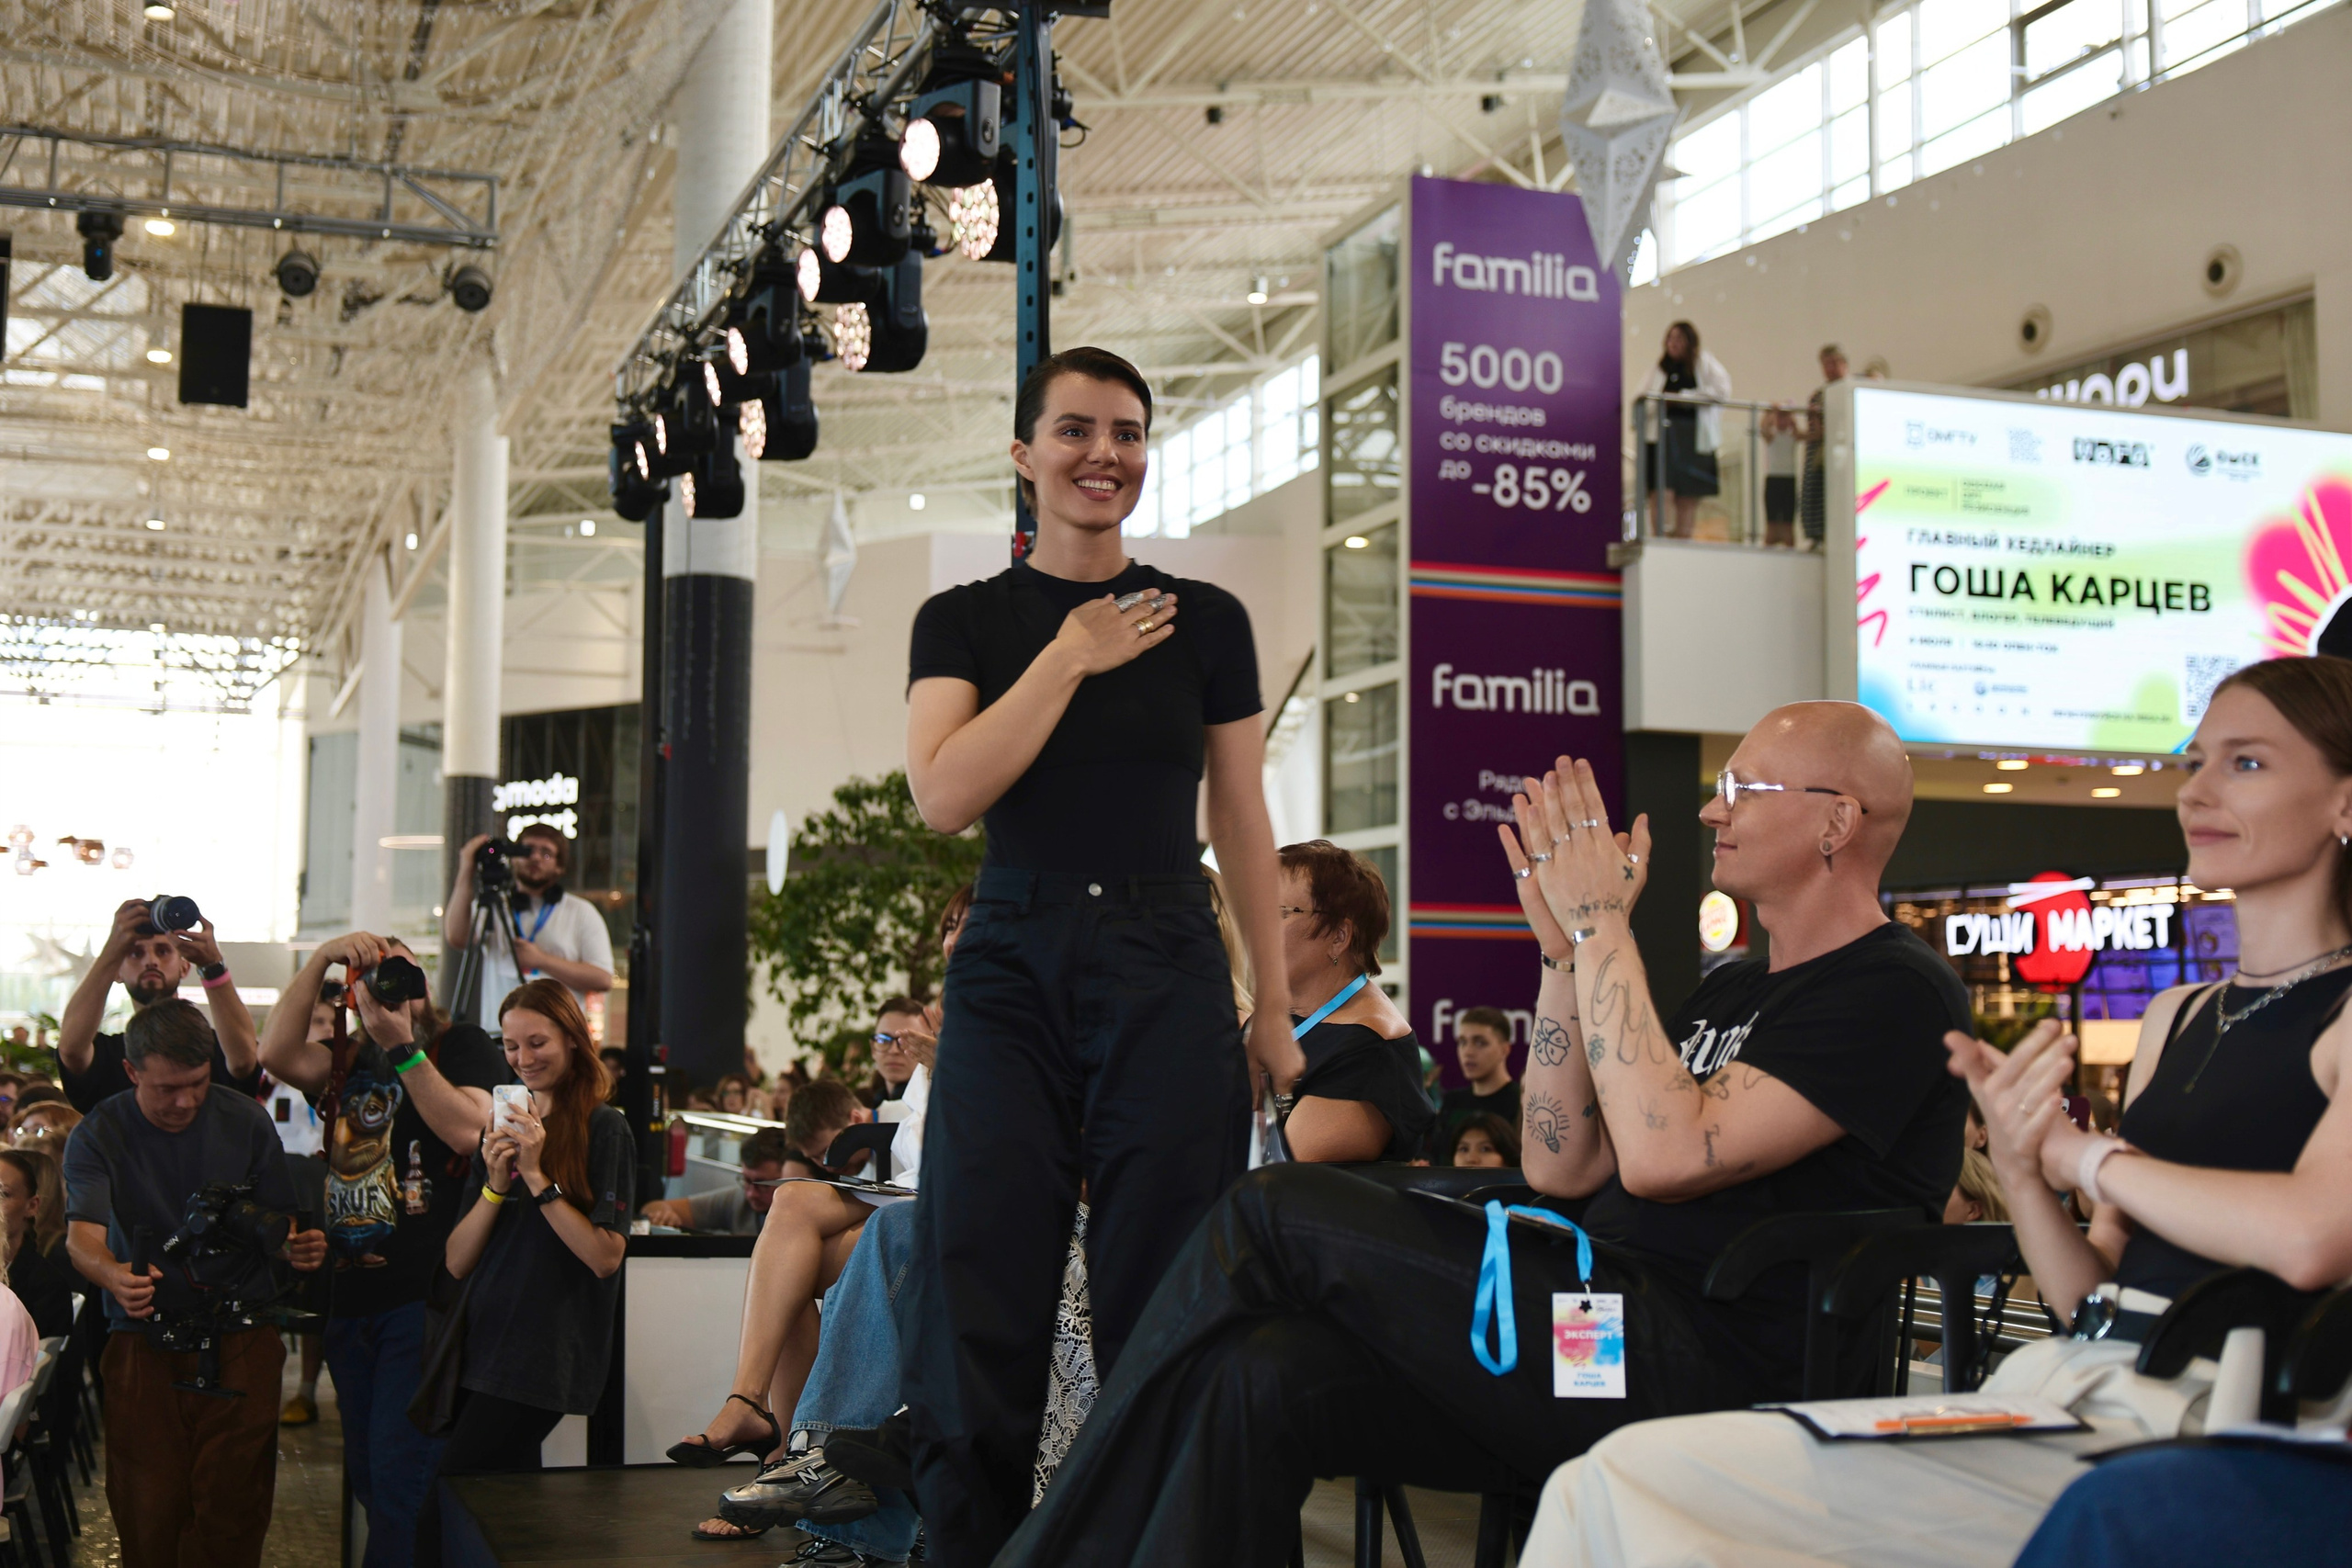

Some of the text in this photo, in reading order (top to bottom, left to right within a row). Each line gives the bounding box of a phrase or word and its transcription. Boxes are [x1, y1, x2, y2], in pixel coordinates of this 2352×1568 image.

[1433, 242, 1600, 301] familia
[1440, 342, 1563, 394] 5000
[1440, 394, 1545, 428] брендов
[1440, 431, 1595, 461] со скидками
[1439, 459, 1591, 513] до -85%
[1907, 529, 2116, 558] ГЛАВНЫЙ ХЕДЛАЙНЕР
[1911, 563, 2211, 614] ГОША КАРЦЕВ
[1432, 663, 1600, 716] familia
[1478, 769, 1544, 795] Ряд
[1442, 802, 1460, 821] с
[1946, 903, 2175, 956] СУШИ МАРКЕТ
[327, 1186, 379, 1218] SKUF
[1564, 1329, 1613, 1340] ЭКСПЕРТ
